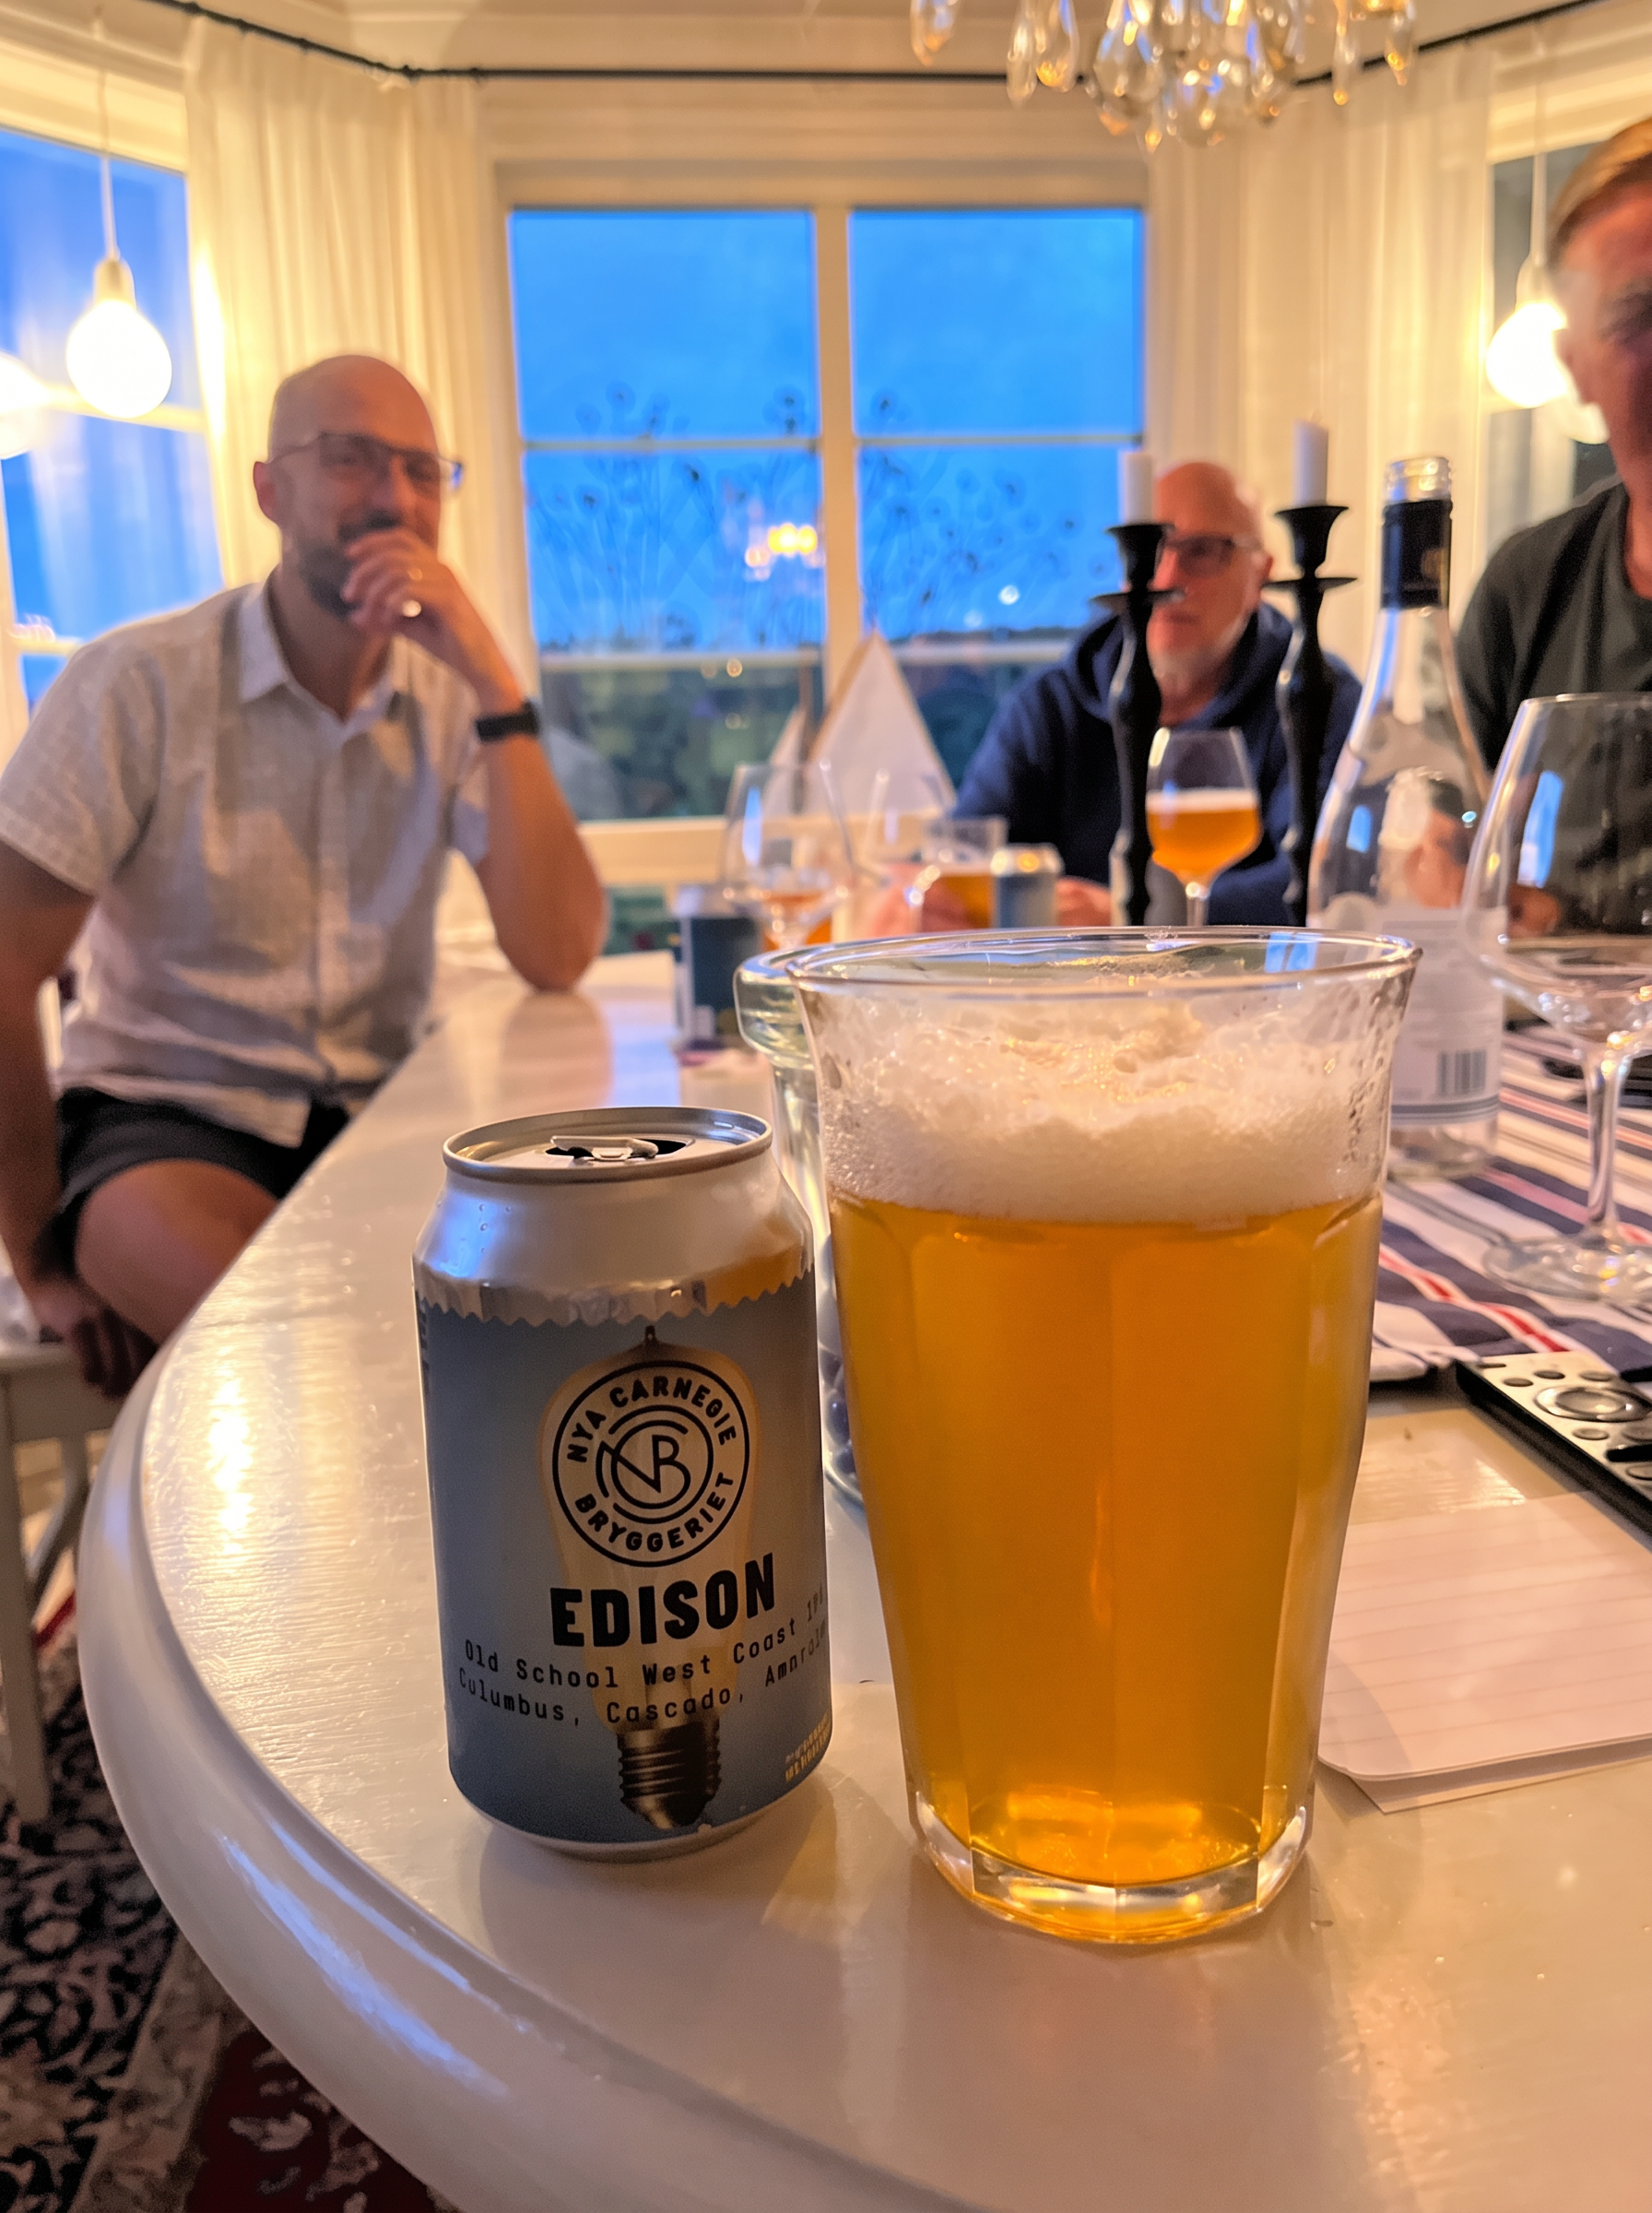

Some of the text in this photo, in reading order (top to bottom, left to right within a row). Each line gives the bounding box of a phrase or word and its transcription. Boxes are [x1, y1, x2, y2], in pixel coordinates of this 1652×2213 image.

[566, 1375, 737, 1462] NYA CARNEGIE
[574, 1472, 734, 1553] BRYGGERIET
[550, 1552, 774, 1647] EDISON
[466, 1639, 499, 1672] Old
[516, 1658, 619, 1688] School
[642, 1654, 711, 1686] West
[733, 1617, 796, 1664] Coast
